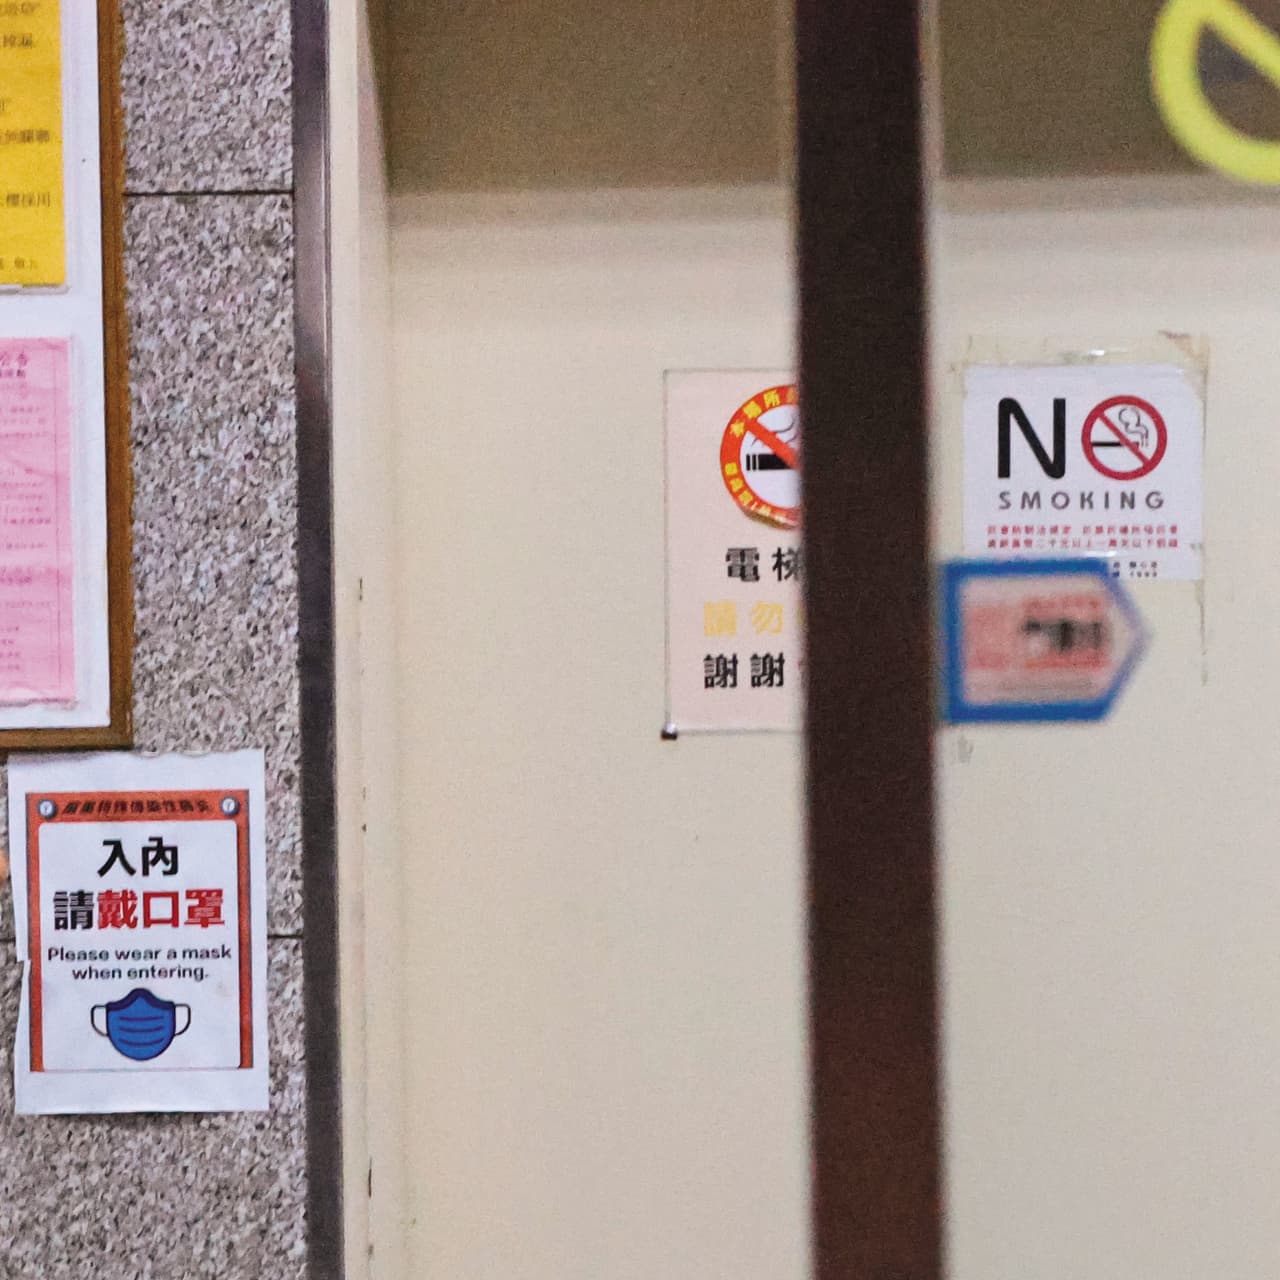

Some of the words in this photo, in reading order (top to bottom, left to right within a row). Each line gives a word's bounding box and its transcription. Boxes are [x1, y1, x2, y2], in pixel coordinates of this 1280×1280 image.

[998, 490, 1166, 511] SMOKING
[703, 652, 785, 688] 謝謝
[97, 836, 179, 877] 入內
[52, 888, 225, 931] 請戴口罩
[47, 947, 110, 962] Please
[115, 950, 162, 962] wear
[166, 949, 178, 961] a
[182, 944, 232, 961] mask
[71, 966, 124, 981] when
[127, 964, 210, 981] entering.
